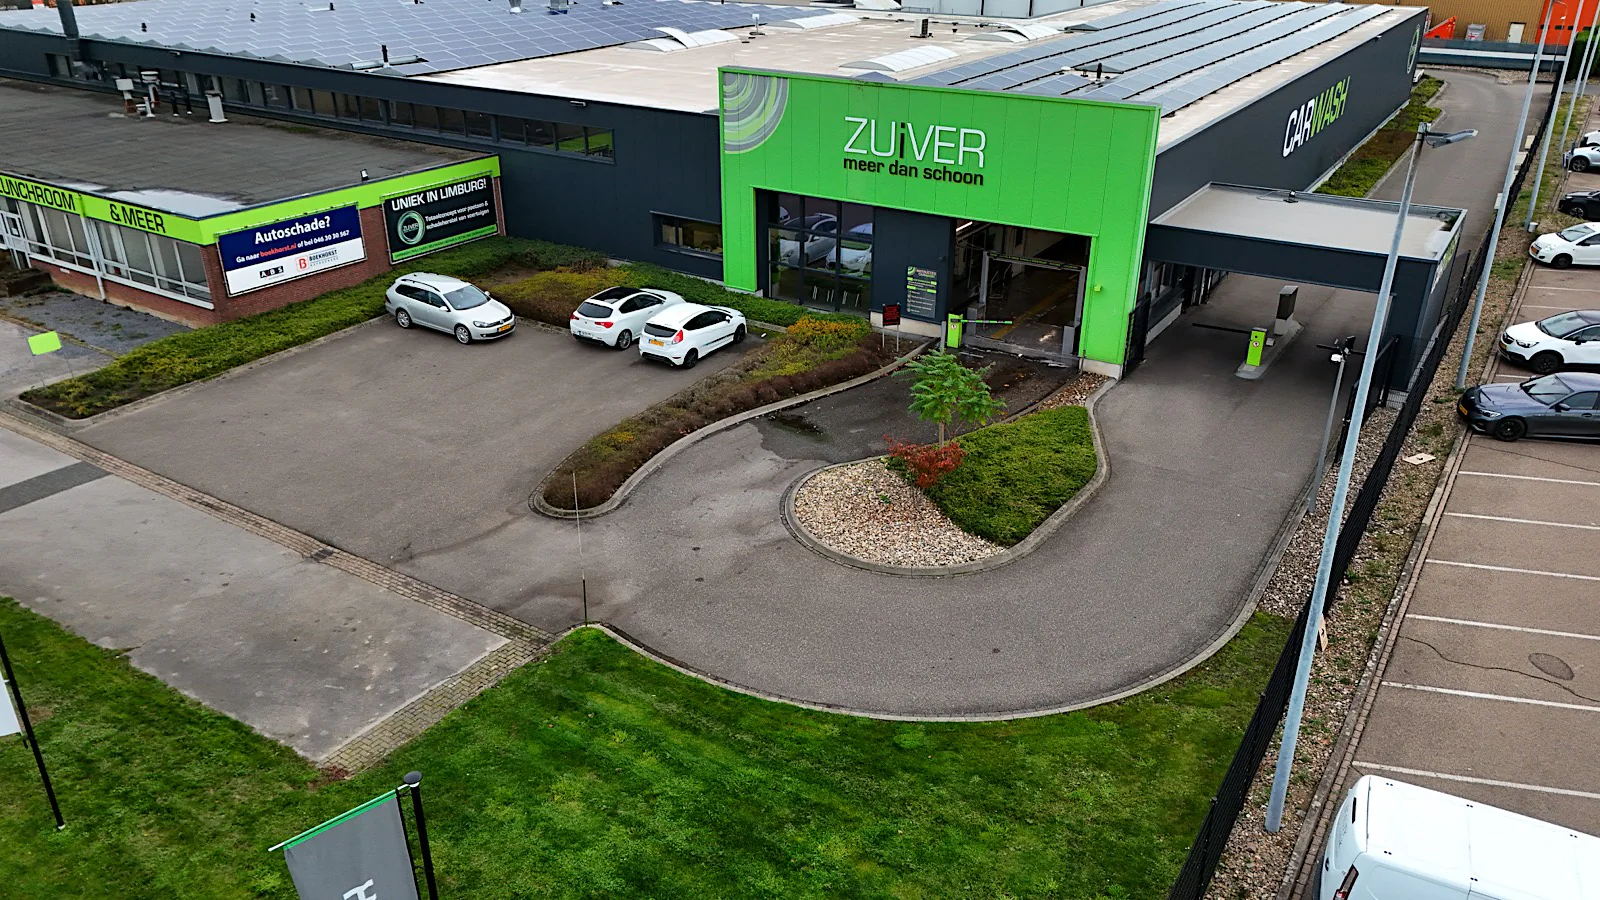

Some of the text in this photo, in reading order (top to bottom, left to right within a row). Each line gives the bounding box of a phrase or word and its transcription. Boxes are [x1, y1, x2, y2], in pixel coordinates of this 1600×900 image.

[1283, 76, 1350, 157] CARWASH
[844, 158, 985, 186] meer dan schoon
[391, 178, 487, 211] UNIEK IN LIMBURG!
[109, 204, 166, 234] & MEER
[255, 216, 331, 244] Autoschade?
[246, 253, 260, 261] naar
[260, 243, 297, 257] boekhorst.nl
[297, 240, 304, 248] of
[304, 238, 313, 246] bel
[313, 236, 324, 244] 046
[332, 232, 340, 240] 30
[309, 250, 337, 261] BOEKHORST
